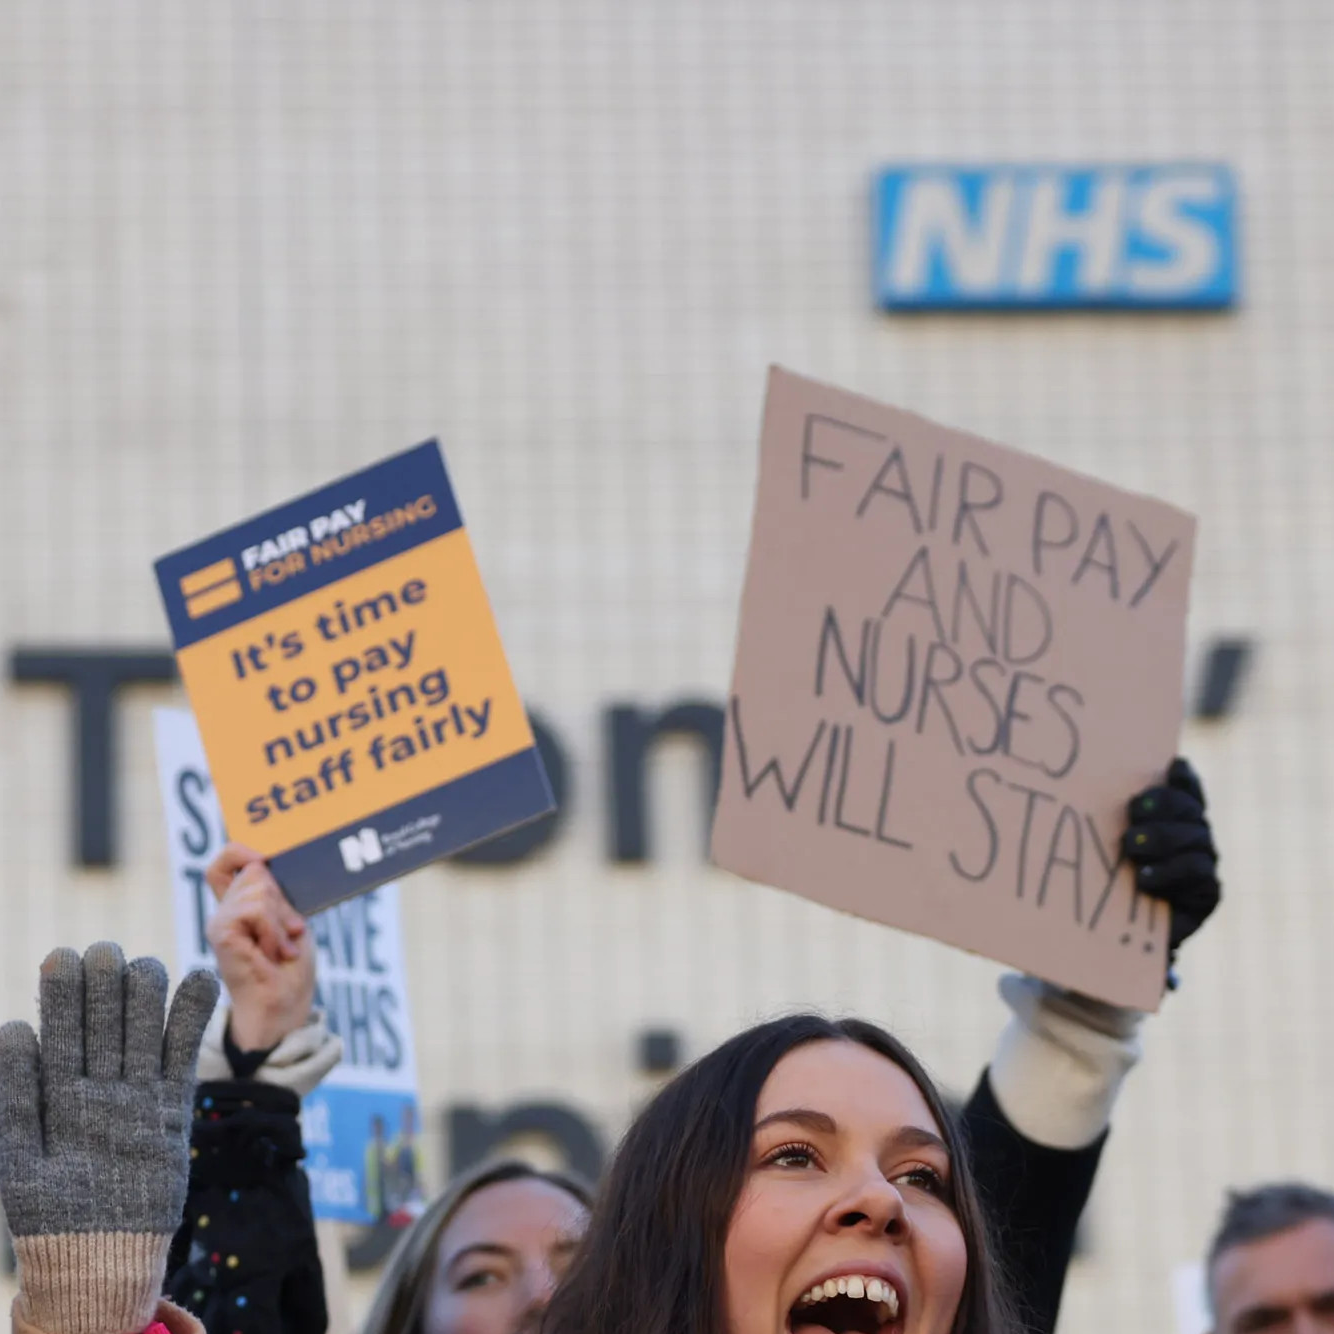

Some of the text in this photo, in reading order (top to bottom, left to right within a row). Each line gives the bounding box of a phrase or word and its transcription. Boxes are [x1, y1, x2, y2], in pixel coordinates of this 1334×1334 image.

[890, 178, 1222, 298] NHS
[241, 499, 366, 571] FAIR PAY
[248, 494, 438, 592] FOR NURSING
[800, 413, 1180, 610] FAIR PAY
[315, 578, 427, 641] time
[880, 545, 1055, 666] AND
[263, 667, 451, 767] nursing
[267, 630, 416, 713] to pay
[814, 604, 1085, 779] NURSES
[245, 748, 354, 824] staff
[368, 697, 492, 771] fairly
[731, 695, 913, 850] WILL
